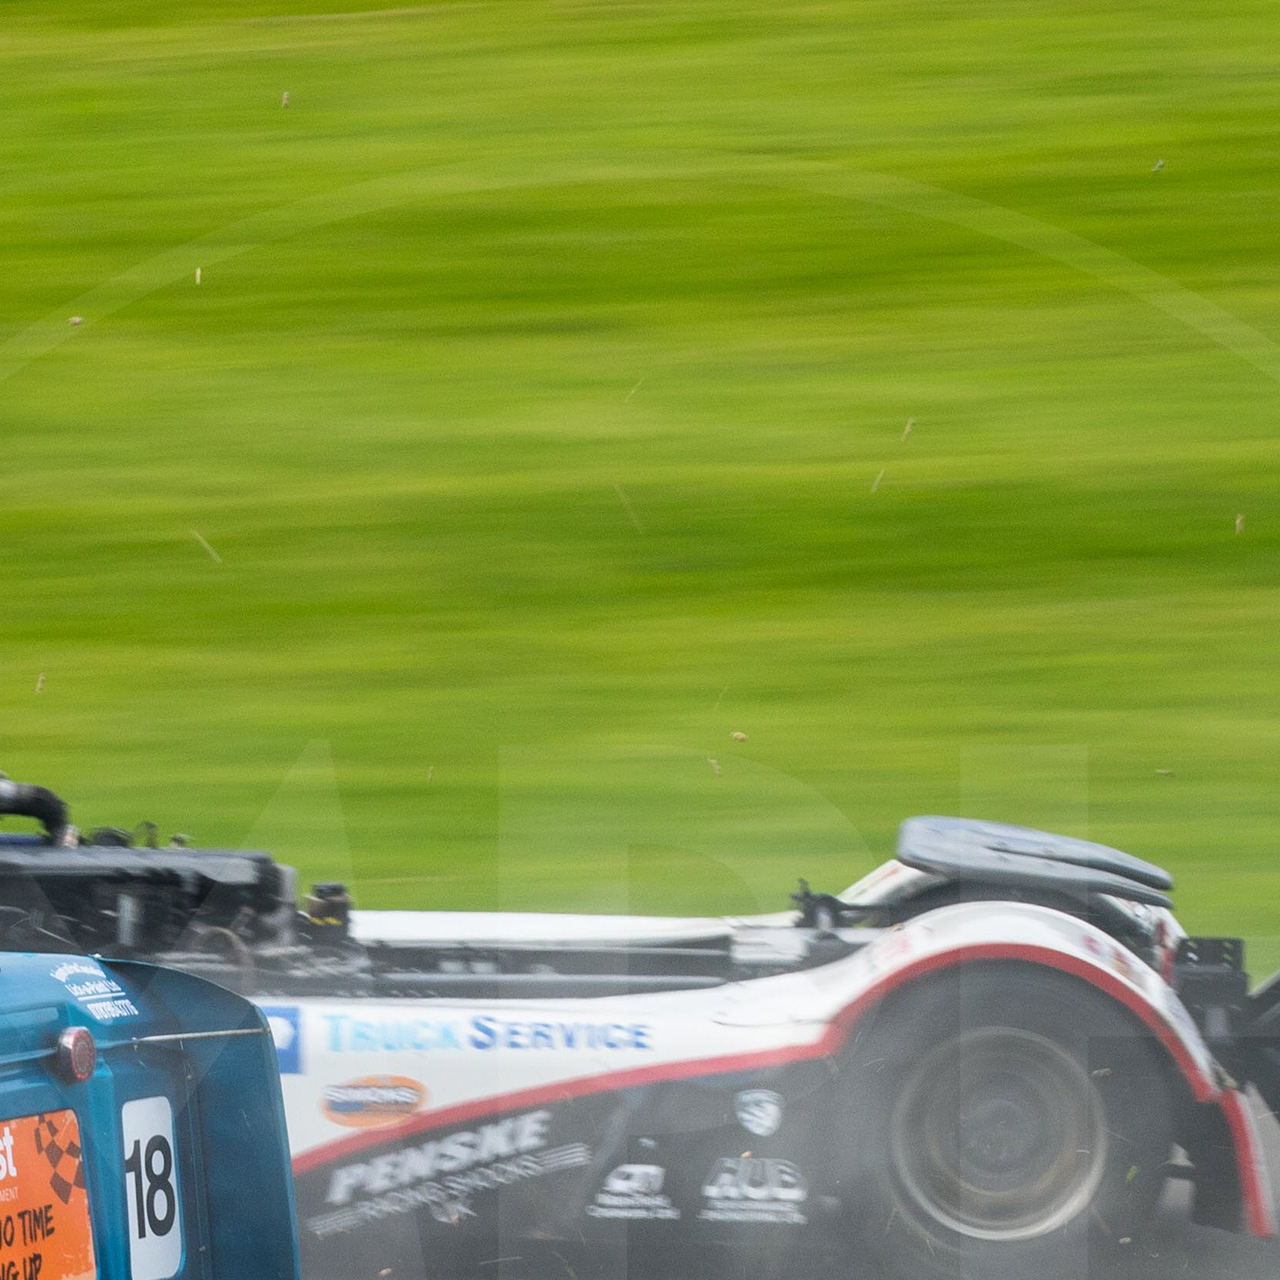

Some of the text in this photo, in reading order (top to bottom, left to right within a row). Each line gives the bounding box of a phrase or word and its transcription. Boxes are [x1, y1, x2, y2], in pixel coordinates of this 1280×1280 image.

[124, 1134, 175, 1238] 18
[325, 1109, 551, 1205] PENSKE
[18, 1205, 55, 1245] TIME
